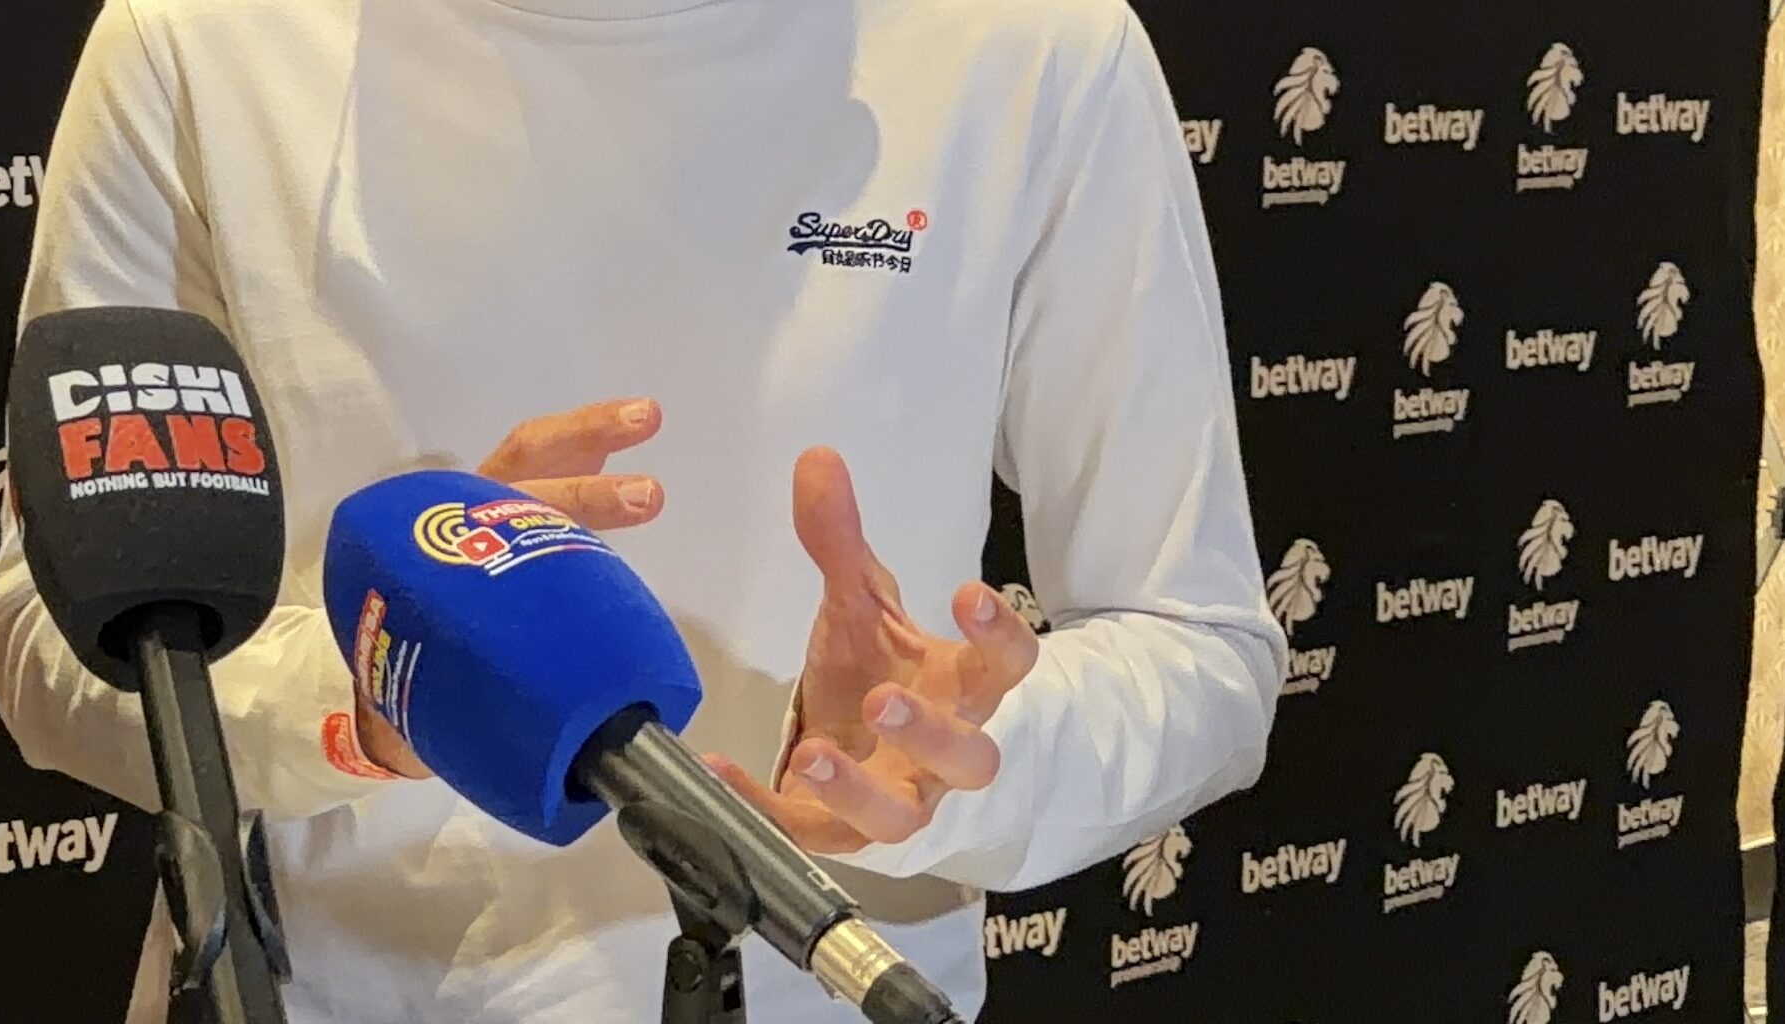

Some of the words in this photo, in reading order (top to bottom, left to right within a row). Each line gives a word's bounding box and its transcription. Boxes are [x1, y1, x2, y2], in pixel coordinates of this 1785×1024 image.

[1384, 104, 1483, 150] betway
[1616, 93, 1710, 142] betway
[1263, 156, 1346, 196] betway
[1517, 144, 1587, 180] betway
[1506, 330, 1597, 372] betway
[1251, 354, 1356, 400] betway
[1628, 360, 1695, 394] betway
[1394, 387, 1470, 422] betway
[59, 414, 264, 480] FANS
[71, 475, 148, 500] NOTHING
[153, 473, 186, 488] BUT
[1608, 534, 1704, 581] betway
[1376, 576, 1475, 624] betway
[1508, 598, 1580, 635] betway
[1496, 778, 1587, 828] betway
[1618, 795, 1684, 833] betway
[1241, 839, 1347, 894] betway
[1383, 853, 1460, 895] betway
[1111, 922, 1199, 967] betway
[1598, 965, 1690, 1024] betway
